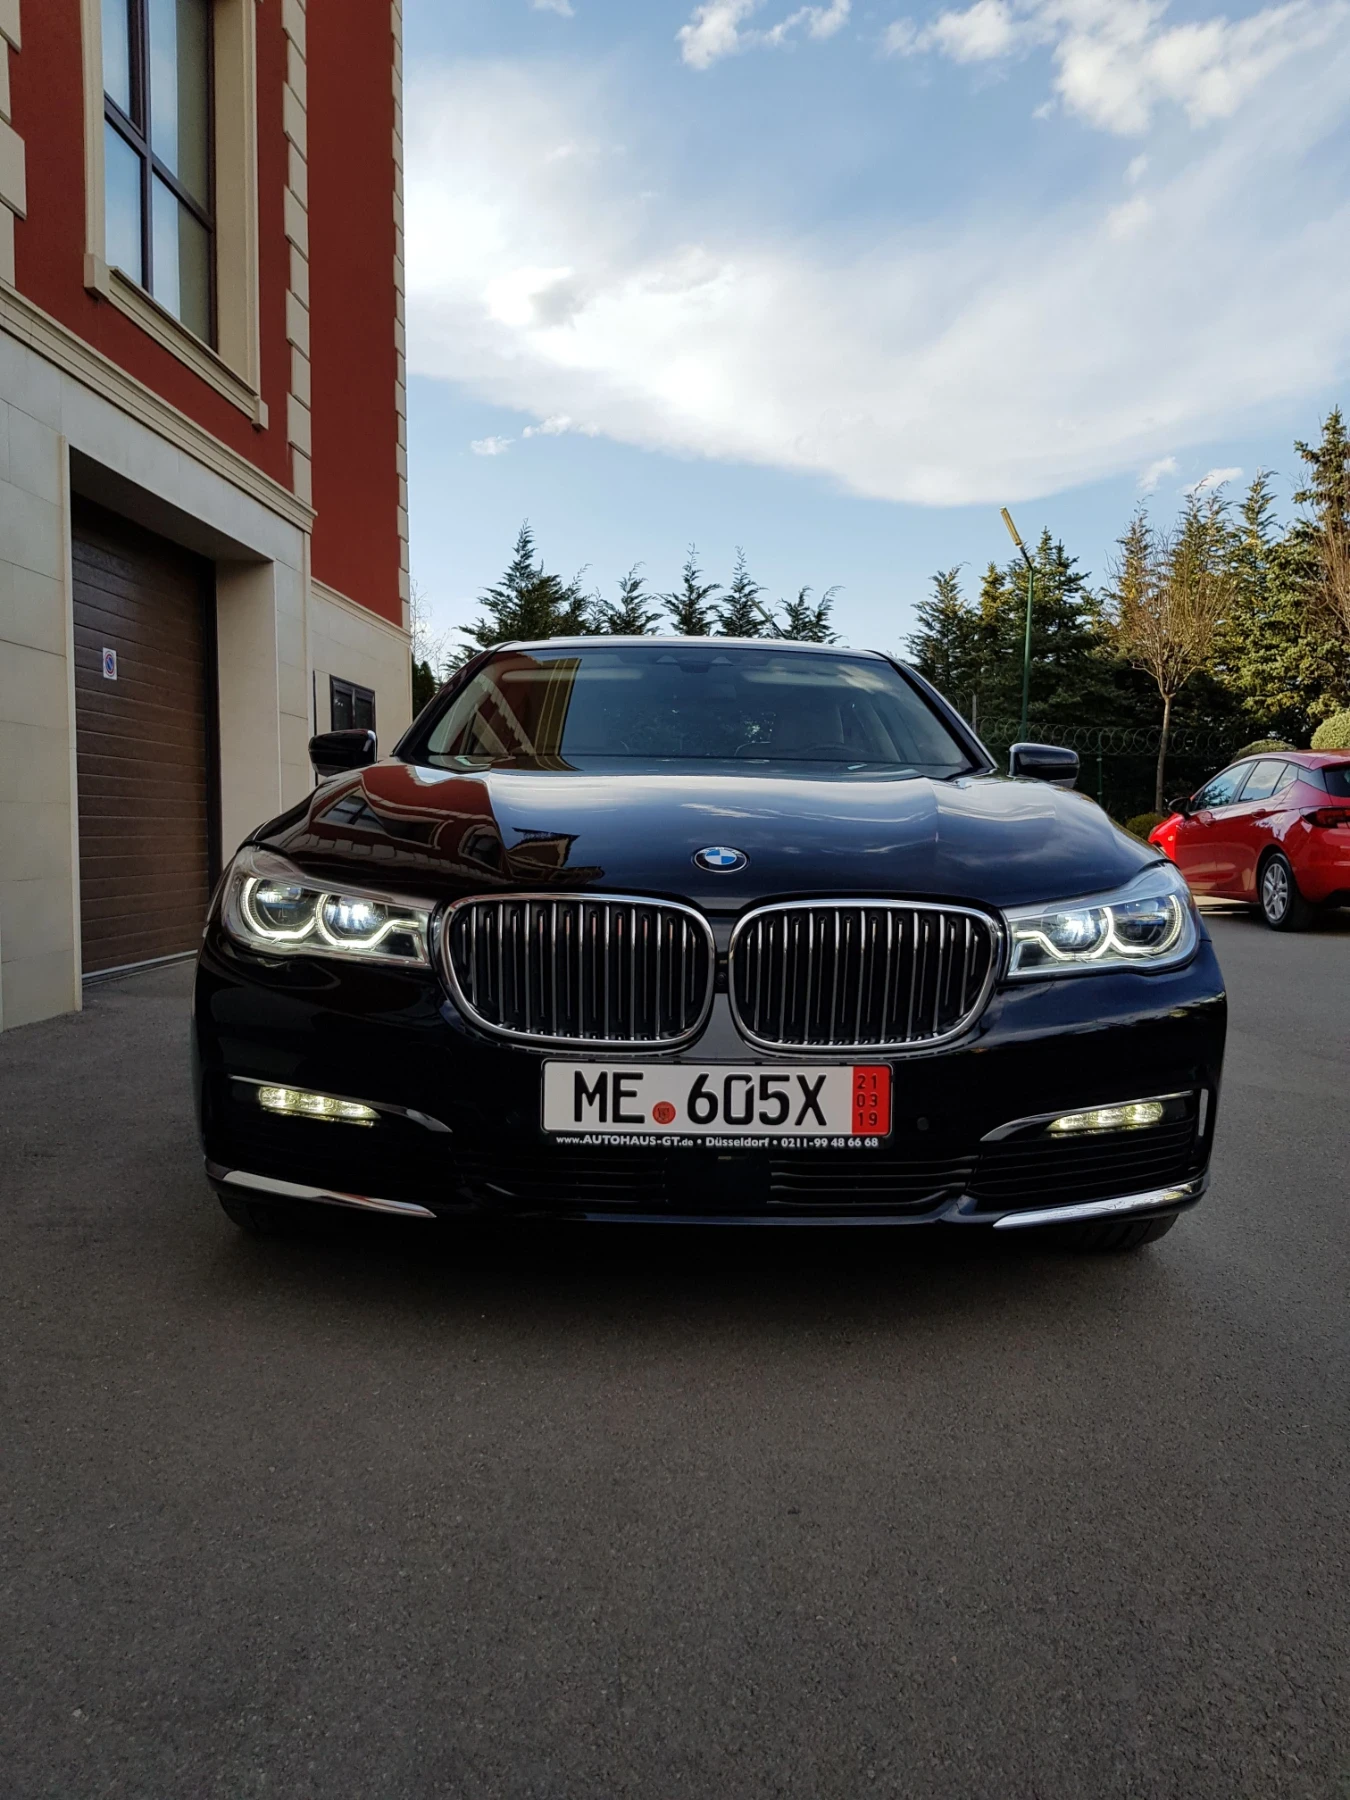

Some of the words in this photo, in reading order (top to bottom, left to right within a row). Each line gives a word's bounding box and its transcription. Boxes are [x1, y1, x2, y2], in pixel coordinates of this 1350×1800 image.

[857, 1073, 877, 1089] 21
[574, 1070, 645, 1124] ME
[687, 1073, 827, 1126] 605X
[856, 1092, 878, 1108] 03
[857, 1110, 878, 1126] 19
[556, 1134, 694, 1146] www.AUTOHAUS-GT.de
[705, 1136, 770, 1148] Düsseldorf
[781, 1137, 828, 1148] 0211-99
[831, 1137, 845, 1147] 48
[847, 1137, 862, 1147] 66
[864, 1137, 879, 1147] 68
